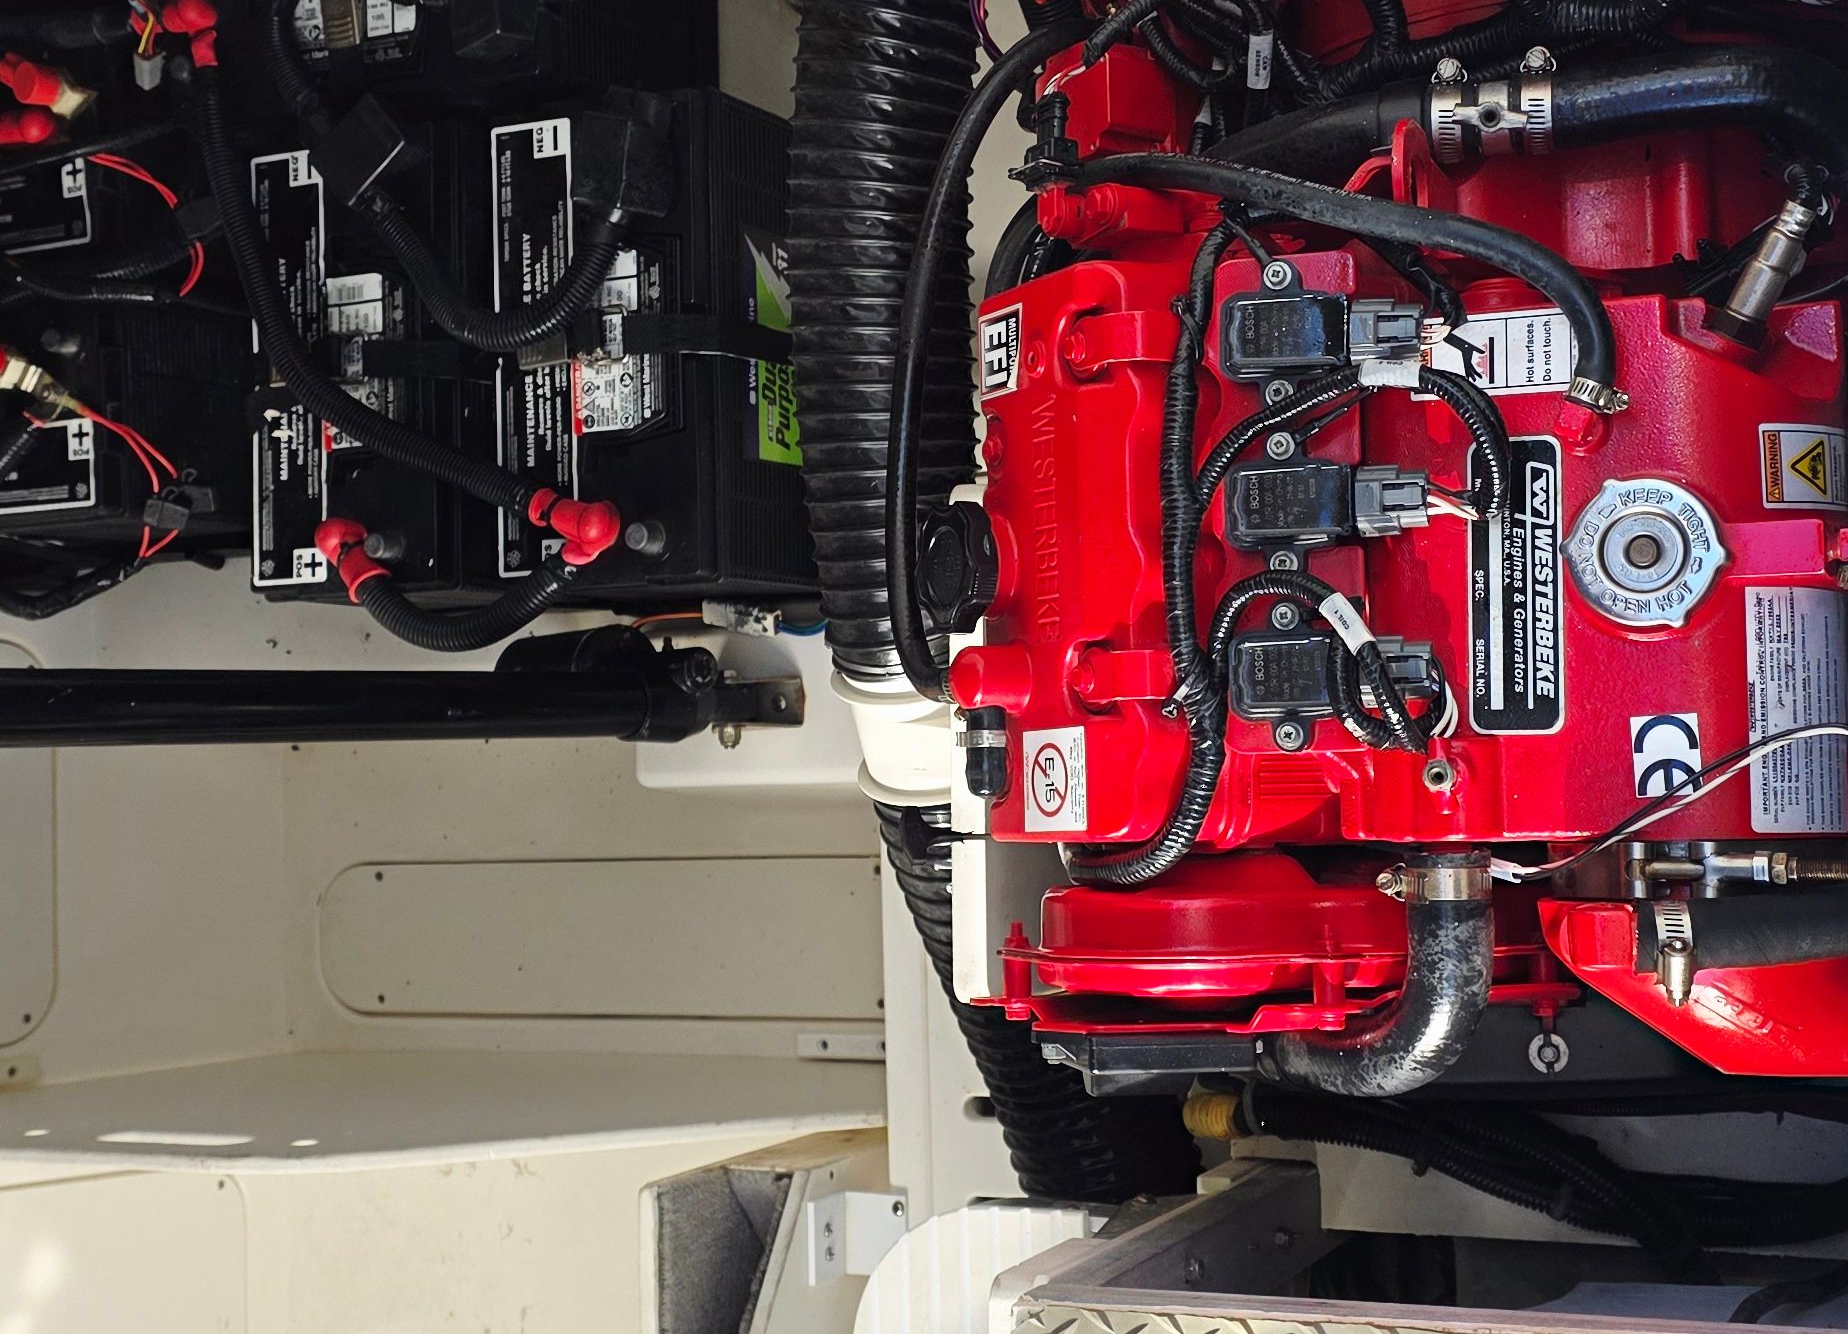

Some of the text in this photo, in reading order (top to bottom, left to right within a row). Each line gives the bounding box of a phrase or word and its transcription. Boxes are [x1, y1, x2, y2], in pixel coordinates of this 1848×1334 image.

[522, 234, 531, 290] BATTERY
[1003, 317, 1018, 373] MULTIPO
[1245, 305, 1254, 338] BOSCH
[1525, 320, 1534, 382] Hot surfaces.
[1542, 318, 1551, 381] Do not touch.
[979, 320, 1011, 388] EFI
[524, 375, 534, 466] MAINTENANCE
[776, 365, 793, 450] Purpo
[1767, 433, 1779, 487] WARNING
[1249, 475, 1259, 508] BOSCH
[1502, 504, 1510, 537] UNTON,
[1618, 488, 1710, 553] KEEP TIGHT
[1031, 397, 1060, 647] WESTERBEKE
[1474, 569, 1484, 600] SPEC.
[1503, 560, 1511, 586] U.S.A.
[1578, 521, 1693, 613] DO NOT OPEN HOT
[1337, 613, 1350, 630] COIL
[1511, 527, 1525, 692] Engines & Generators
[1534, 529, 1554, 696] WESTERBEKE
[1254, 647, 1264, 680] BOSCH
[1475, 638, 1485, 697] SERIAL NO.
[1044, 757, 1055, 802] E-15
[1634, 715, 1702, 796] CE
